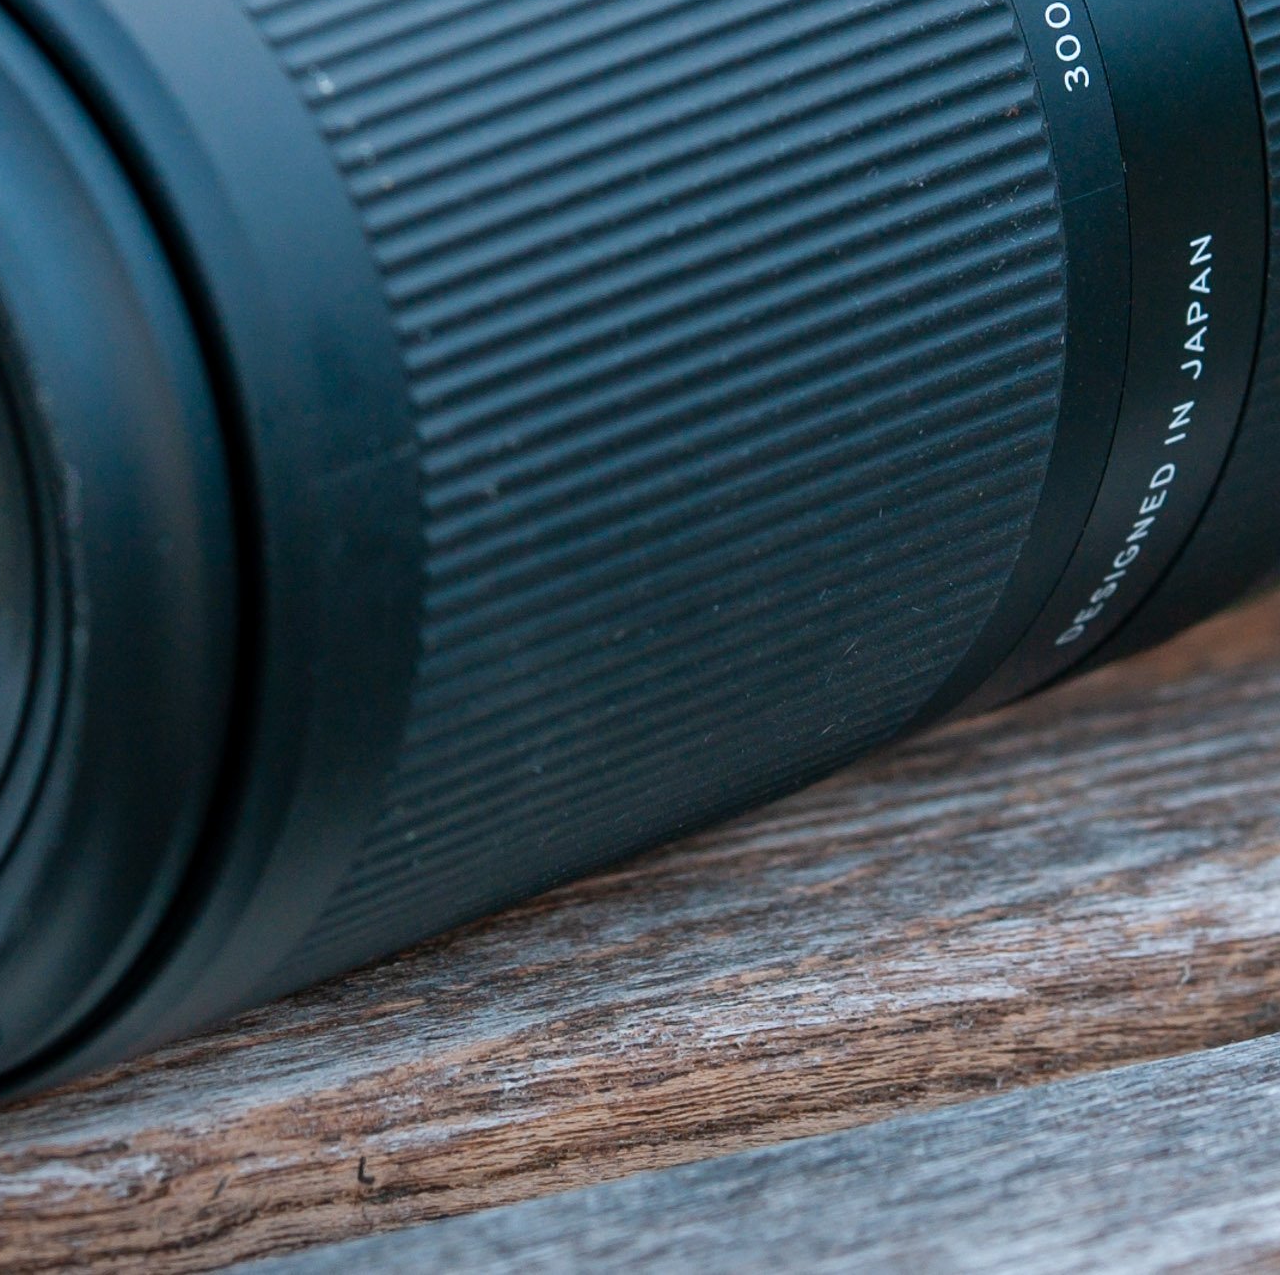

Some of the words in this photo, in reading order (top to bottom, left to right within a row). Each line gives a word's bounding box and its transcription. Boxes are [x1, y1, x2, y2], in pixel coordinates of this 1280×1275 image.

[1044, 1, 1090, 92] 300
[1055, 462, 1176, 647] DESIGNED
[1164, 400, 1195, 446] IN
[1181, 234, 1213, 381] JAPAN
